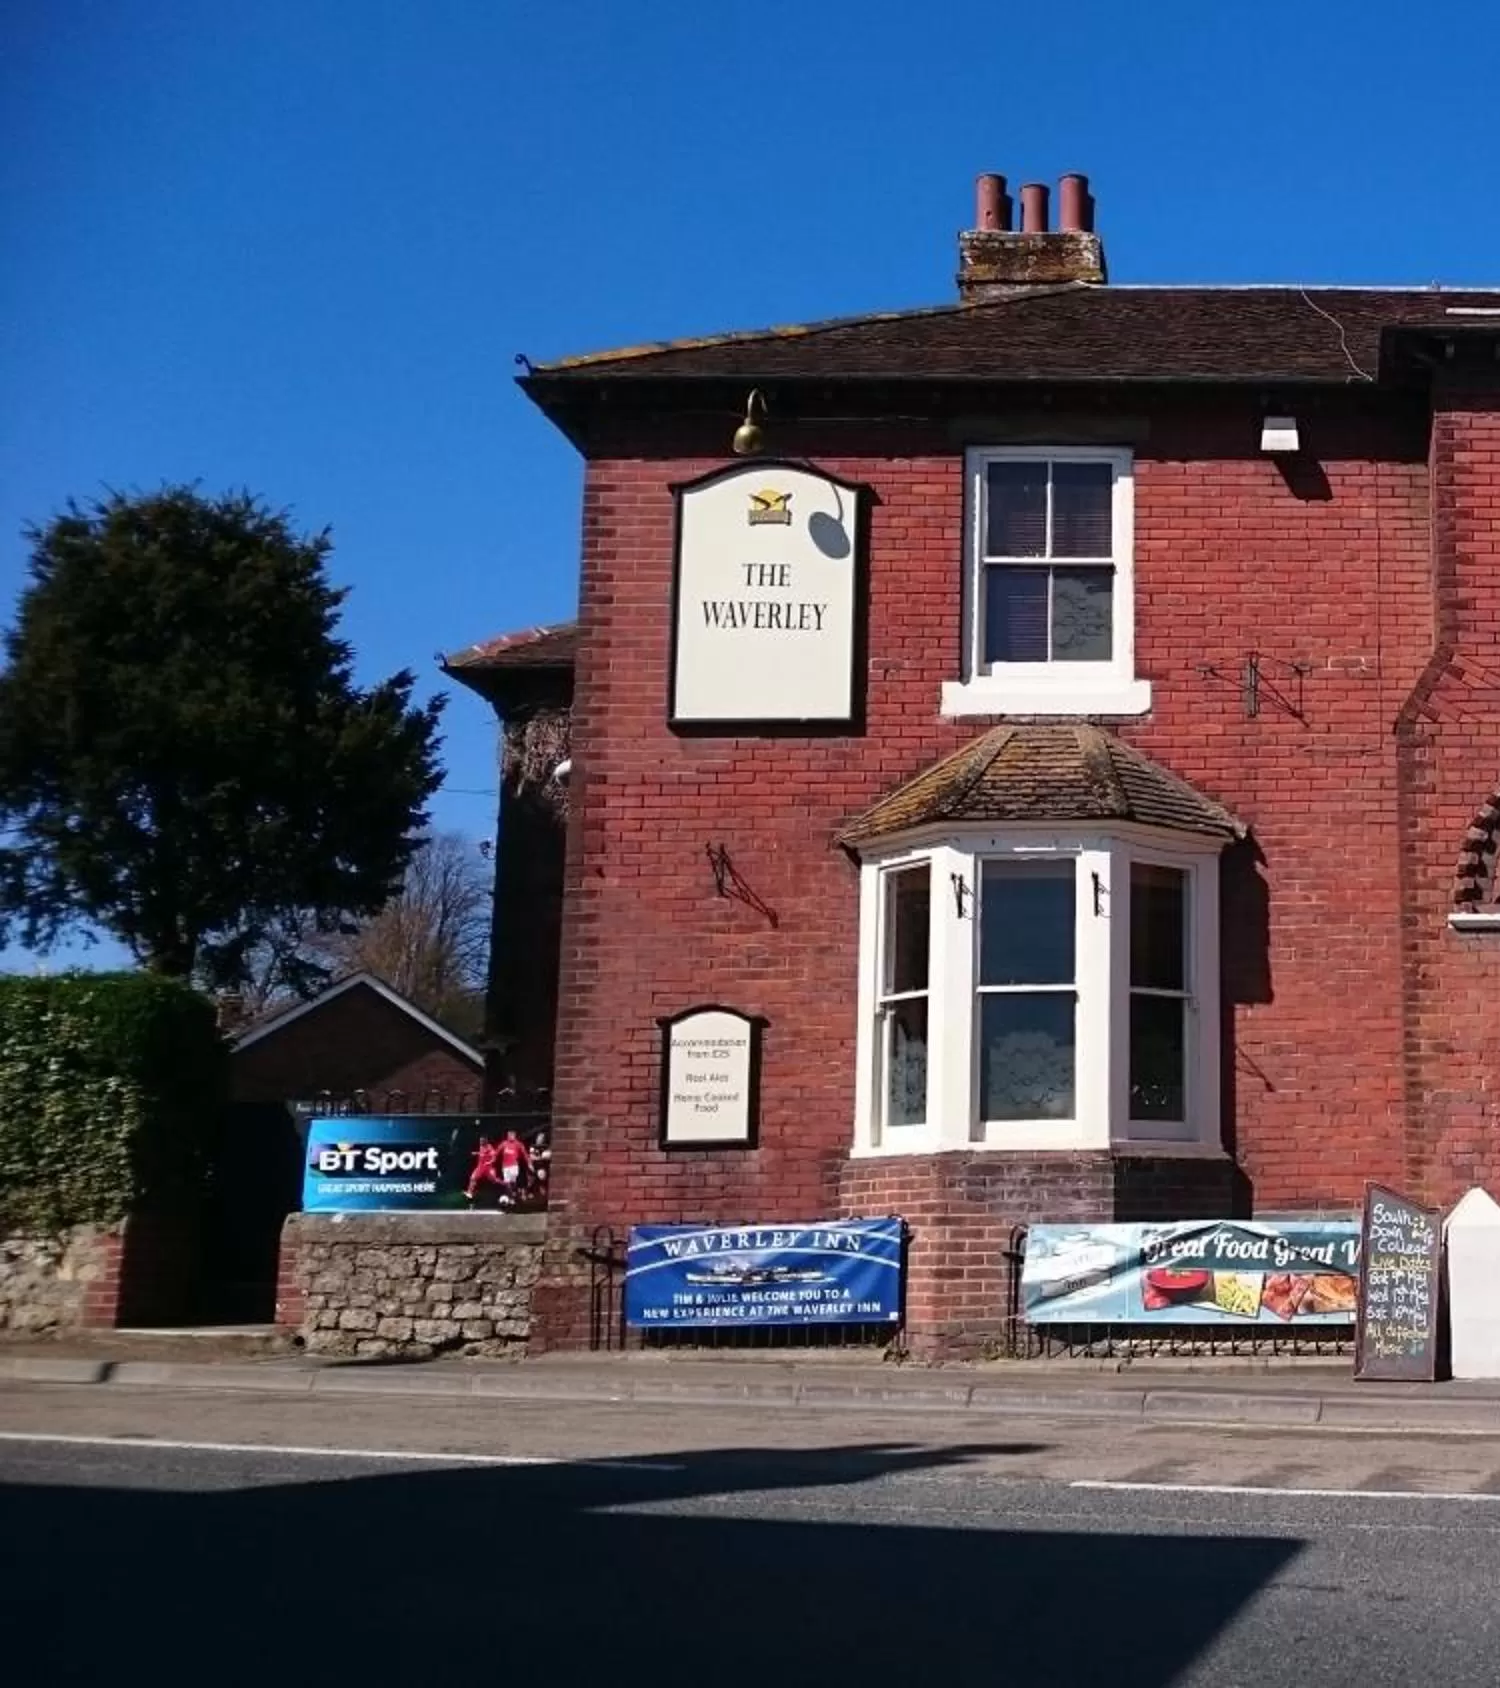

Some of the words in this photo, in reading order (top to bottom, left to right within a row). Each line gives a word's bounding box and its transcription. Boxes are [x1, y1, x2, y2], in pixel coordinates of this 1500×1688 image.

[742, 563, 791, 587] THE
[703, 601, 827, 631] WAVERLEY
[319, 1149, 361, 1170] BT
[364, 1147, 438, 1175] Sport
[413, 1182, 436, 1193] HERE
[664, 1231, 802, 1257] WAVERLEY
[813, 1232, 861, 1251] INN
[1144, 1233, 1208, 1263] Great
[1214, 1233, 1268, 1259] Food
[1273, 1237, 1333, 1266] Great
[741, 1289, 796, 1302] WELCOME
[800, 1289, 821, 1300] YOU
[824, 1289, 839, 1299] TO
[842, 1288, 851, 1298] A
[643, 1308, 669, 1318] NEW
[673, 1306, 745, 1318] EXPERIENCE
[749, 1306, 762, 1316] AT
[767, 1305, 789, 1316] THE
[793, 1303, 852, 1315] WAVERLEY
[857, 1301, 881, 1312] INN
